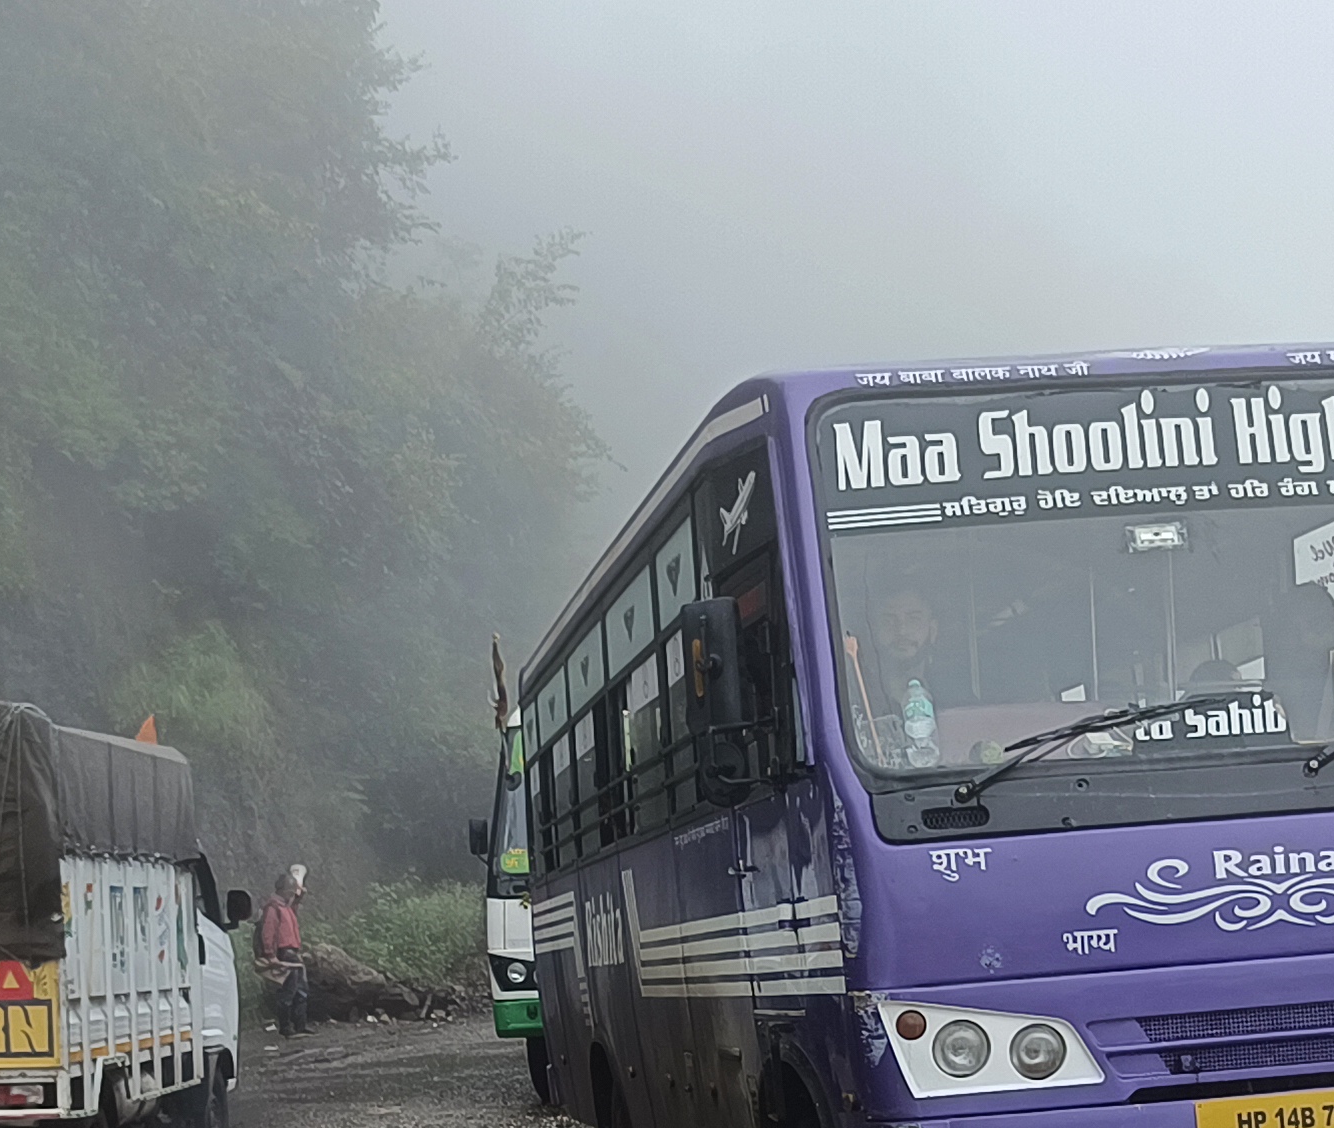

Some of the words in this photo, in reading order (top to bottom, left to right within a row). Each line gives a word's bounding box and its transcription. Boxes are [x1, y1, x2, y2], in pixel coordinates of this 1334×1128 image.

[1286, 351, 1322, 365] जय
[855, 371, 892, 387] जय
[898, 369, 945, 384] बाबा
[1018, 363, 1058, 379] नाथ
[1063, 361, 1090, 377] जी
[833, 420, 961, 491] Maa
[977, 387, 1218, 480] Shoolini
[1184, 693, 1287, 738] Sahib
[929, 848, 992, 881] शुभ
[1063, 929, 1118, 954] भाग्य
[1275, 1106, 1315, 1128] 14B
